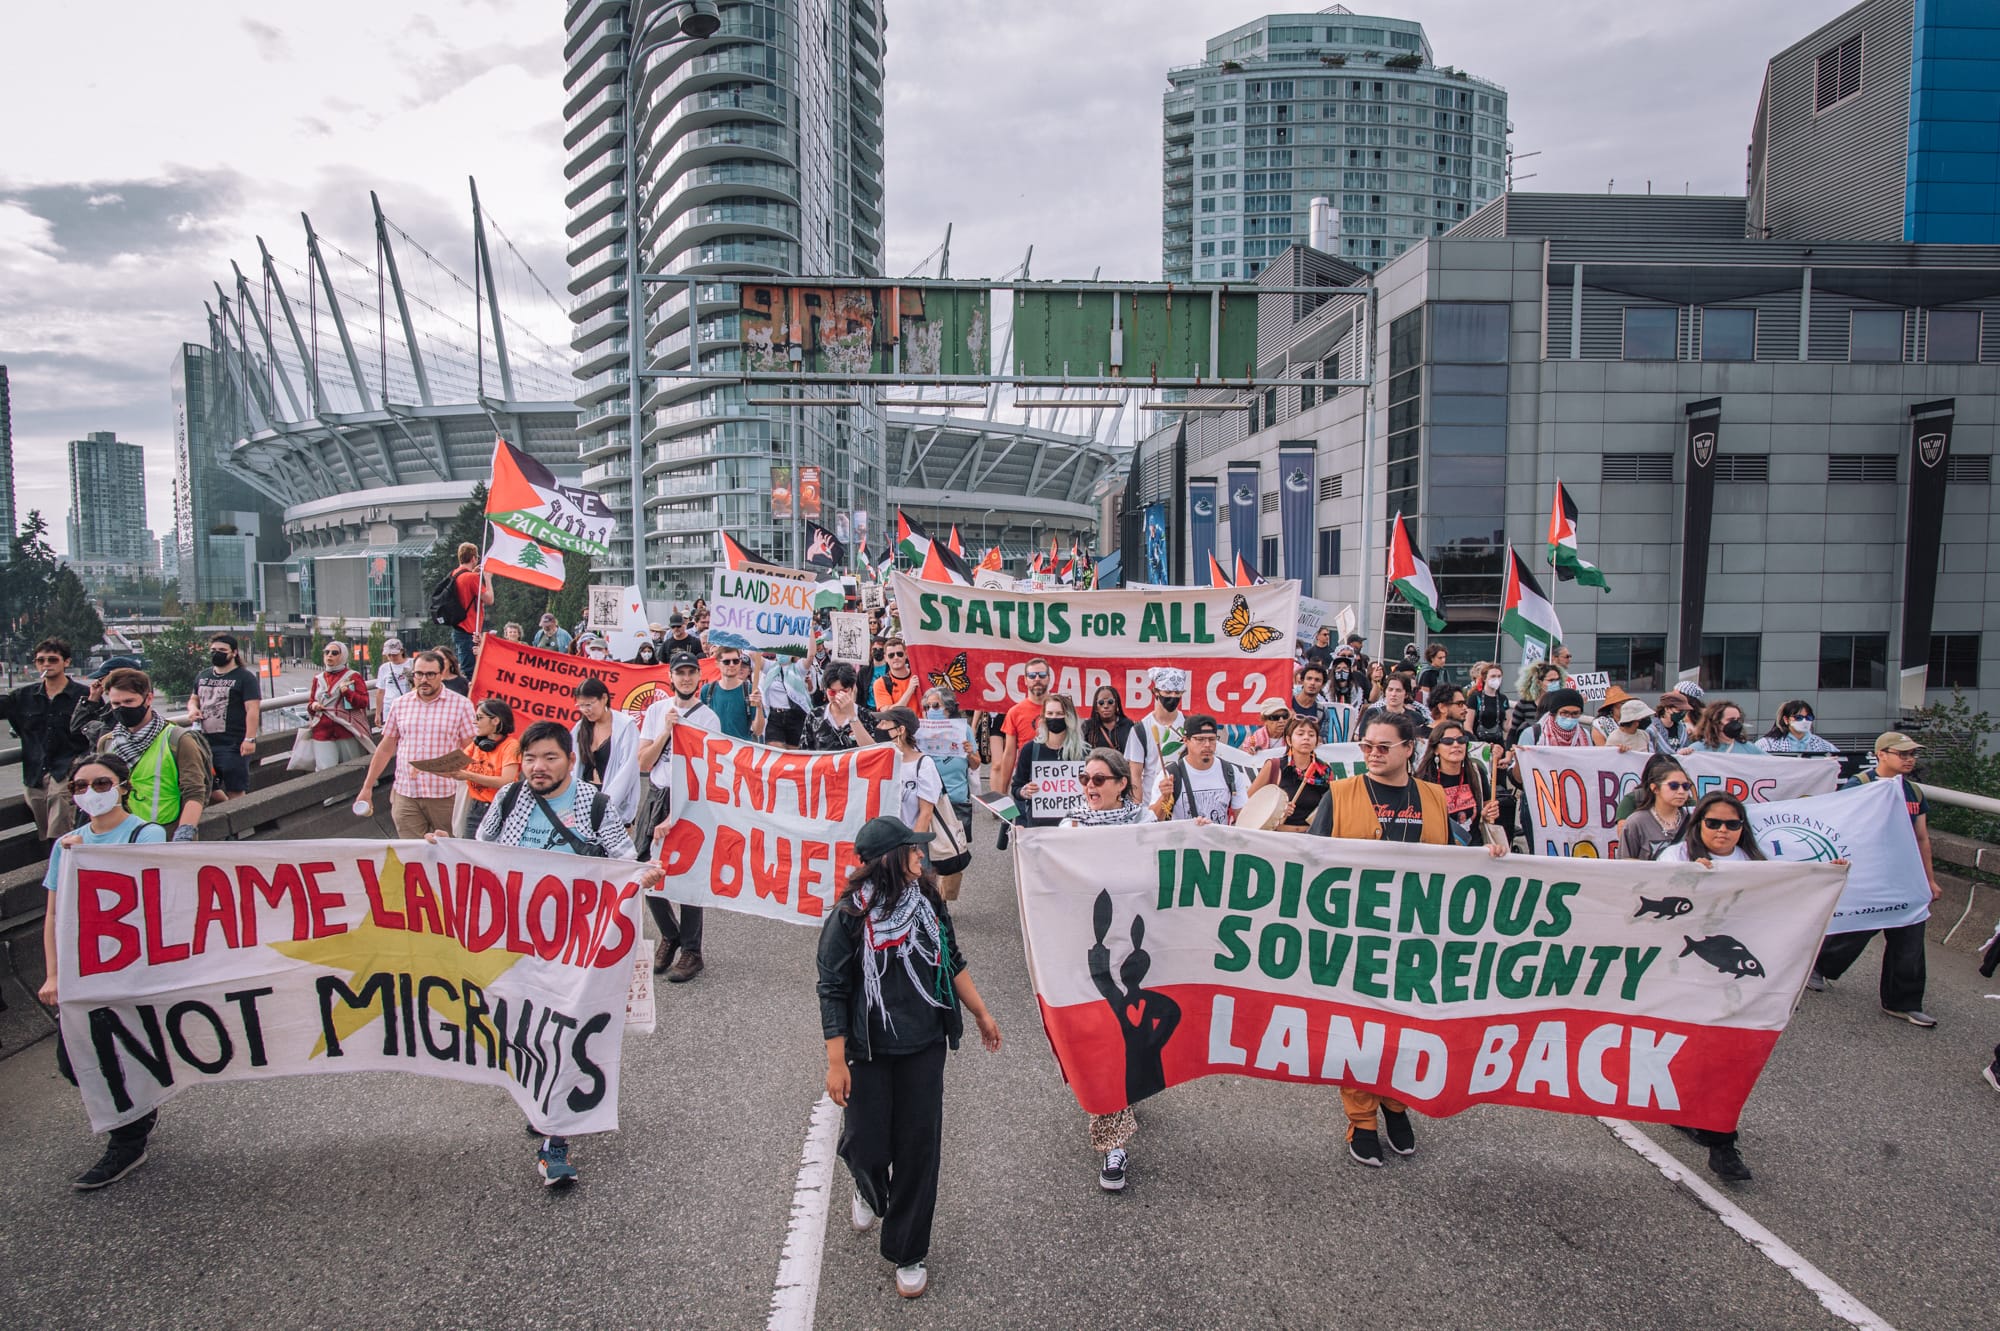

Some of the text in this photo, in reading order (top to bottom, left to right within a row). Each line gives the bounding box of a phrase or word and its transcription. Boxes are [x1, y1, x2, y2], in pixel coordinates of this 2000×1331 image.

[713, 604, 755, 630] SAFE
[919, 592, 1071, 643] STATUS
[1081, 613, 1126, 637] FOR
[1139, 601, 1215, 643] ALL
[495, 668, 516, 683] IN
[519, 675, 577, 699] SUPPO
[516, 651, 620, 683] IMMIGRANTS
[1576, 672, 1607, 686] GAZA
[485, 689, 583, 722] INDIGENO
[1206, 671, 1267, 713] C-2
[671, 723, 896, 822] TENANT
[1034, 764, 1085, 778] PEOPLE
[1042, 780, 1078, 793] OVER
[1034, 794, 1083, 811] PROPERT
[1532, 768, 1588, 829] NO
[1763, 813, 1840, 841] MIGRANTS
[1156, 848, 1581, 938] INDIGENOUS
[78, 858, 640, 977] BLAME LANDLORDS
[1213, 914, 1662, 1003] SOVEREIGNTY
[89, 986, 273, 1113] NOT
[316, 972, 611, 1116] MIGRANTS
[1207, 994, 1688, 1111] LAND BACK
